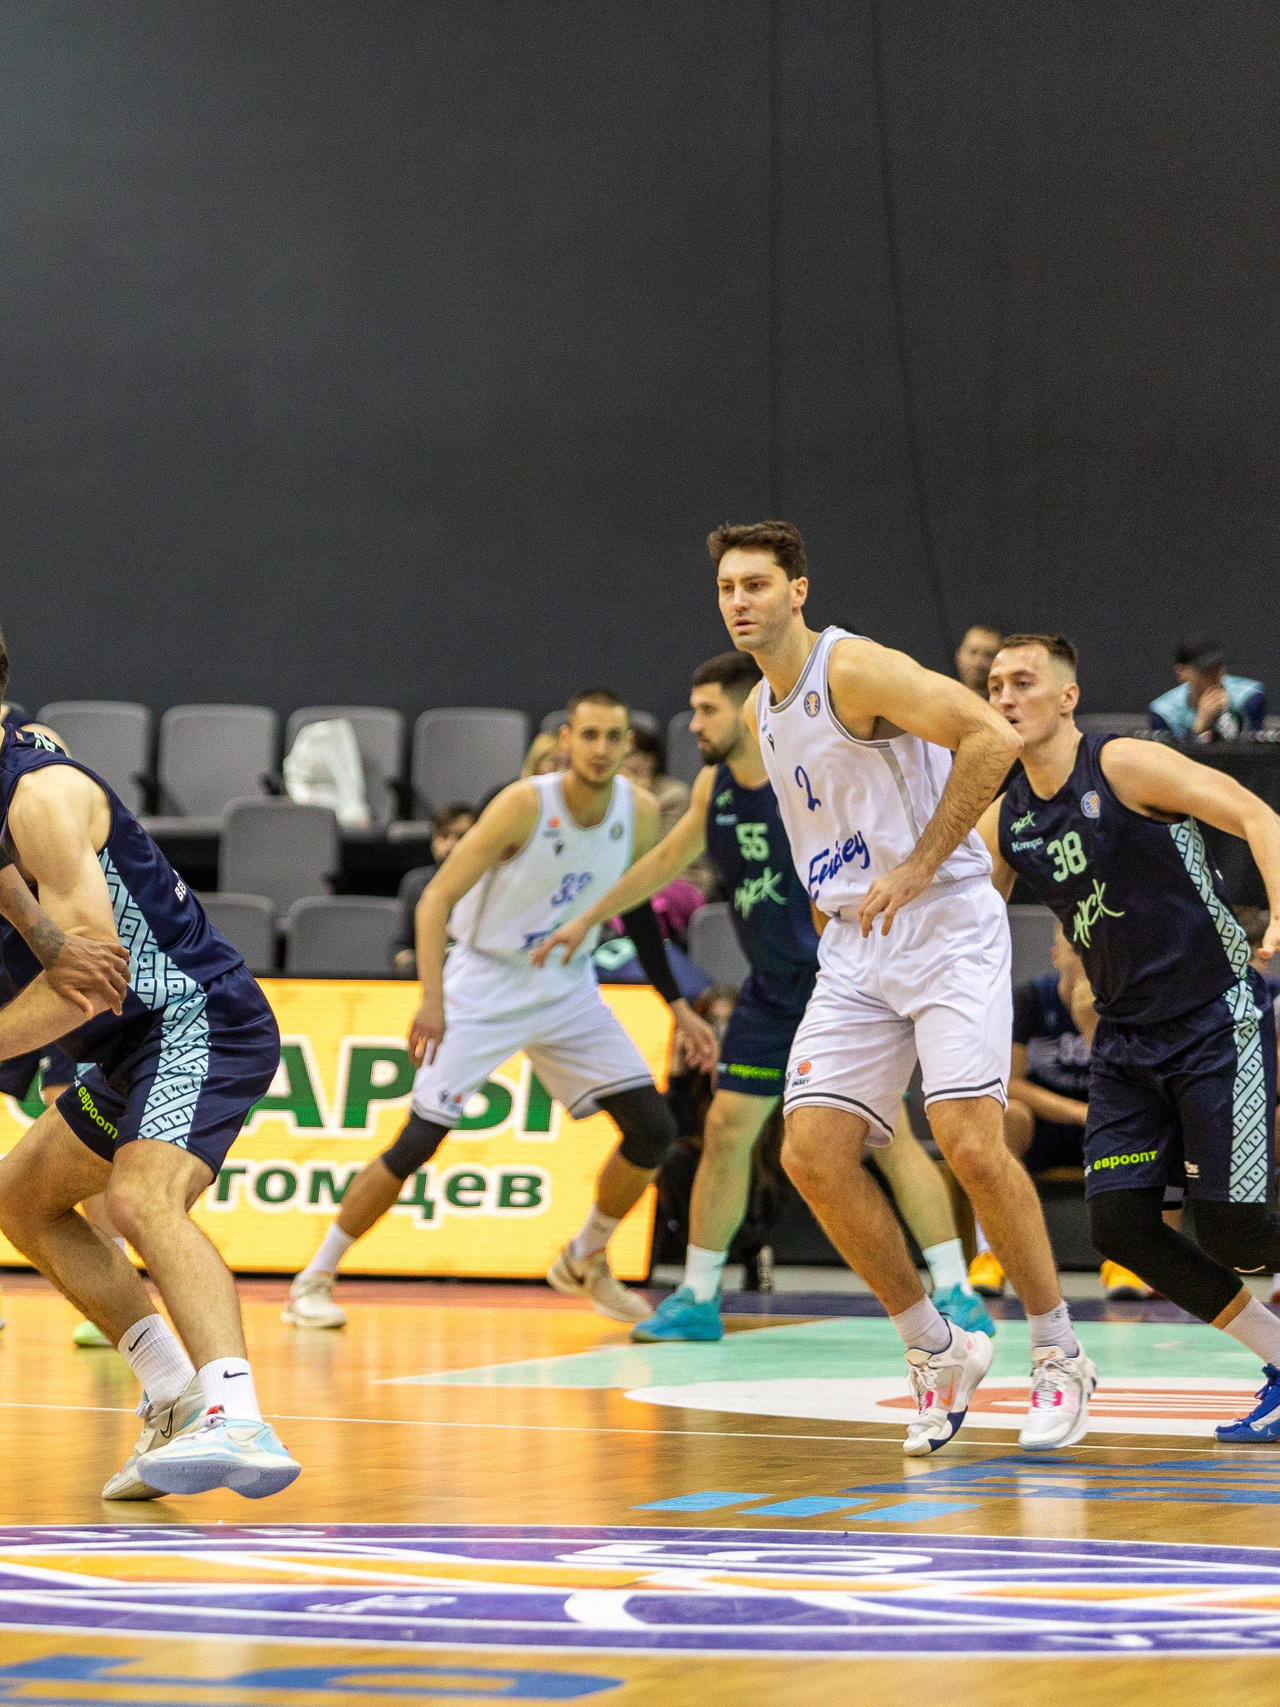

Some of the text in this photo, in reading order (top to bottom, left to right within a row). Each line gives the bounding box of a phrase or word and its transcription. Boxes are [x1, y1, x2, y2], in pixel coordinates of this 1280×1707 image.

[795, 765, 821, 812] 2
[736, 823, 770, 862] 55
[1047, 831, 1087, 882] 38
[78, 1086, 119, 1140] евроопт
[1093, 1150, 1158, 1171] евроопт
